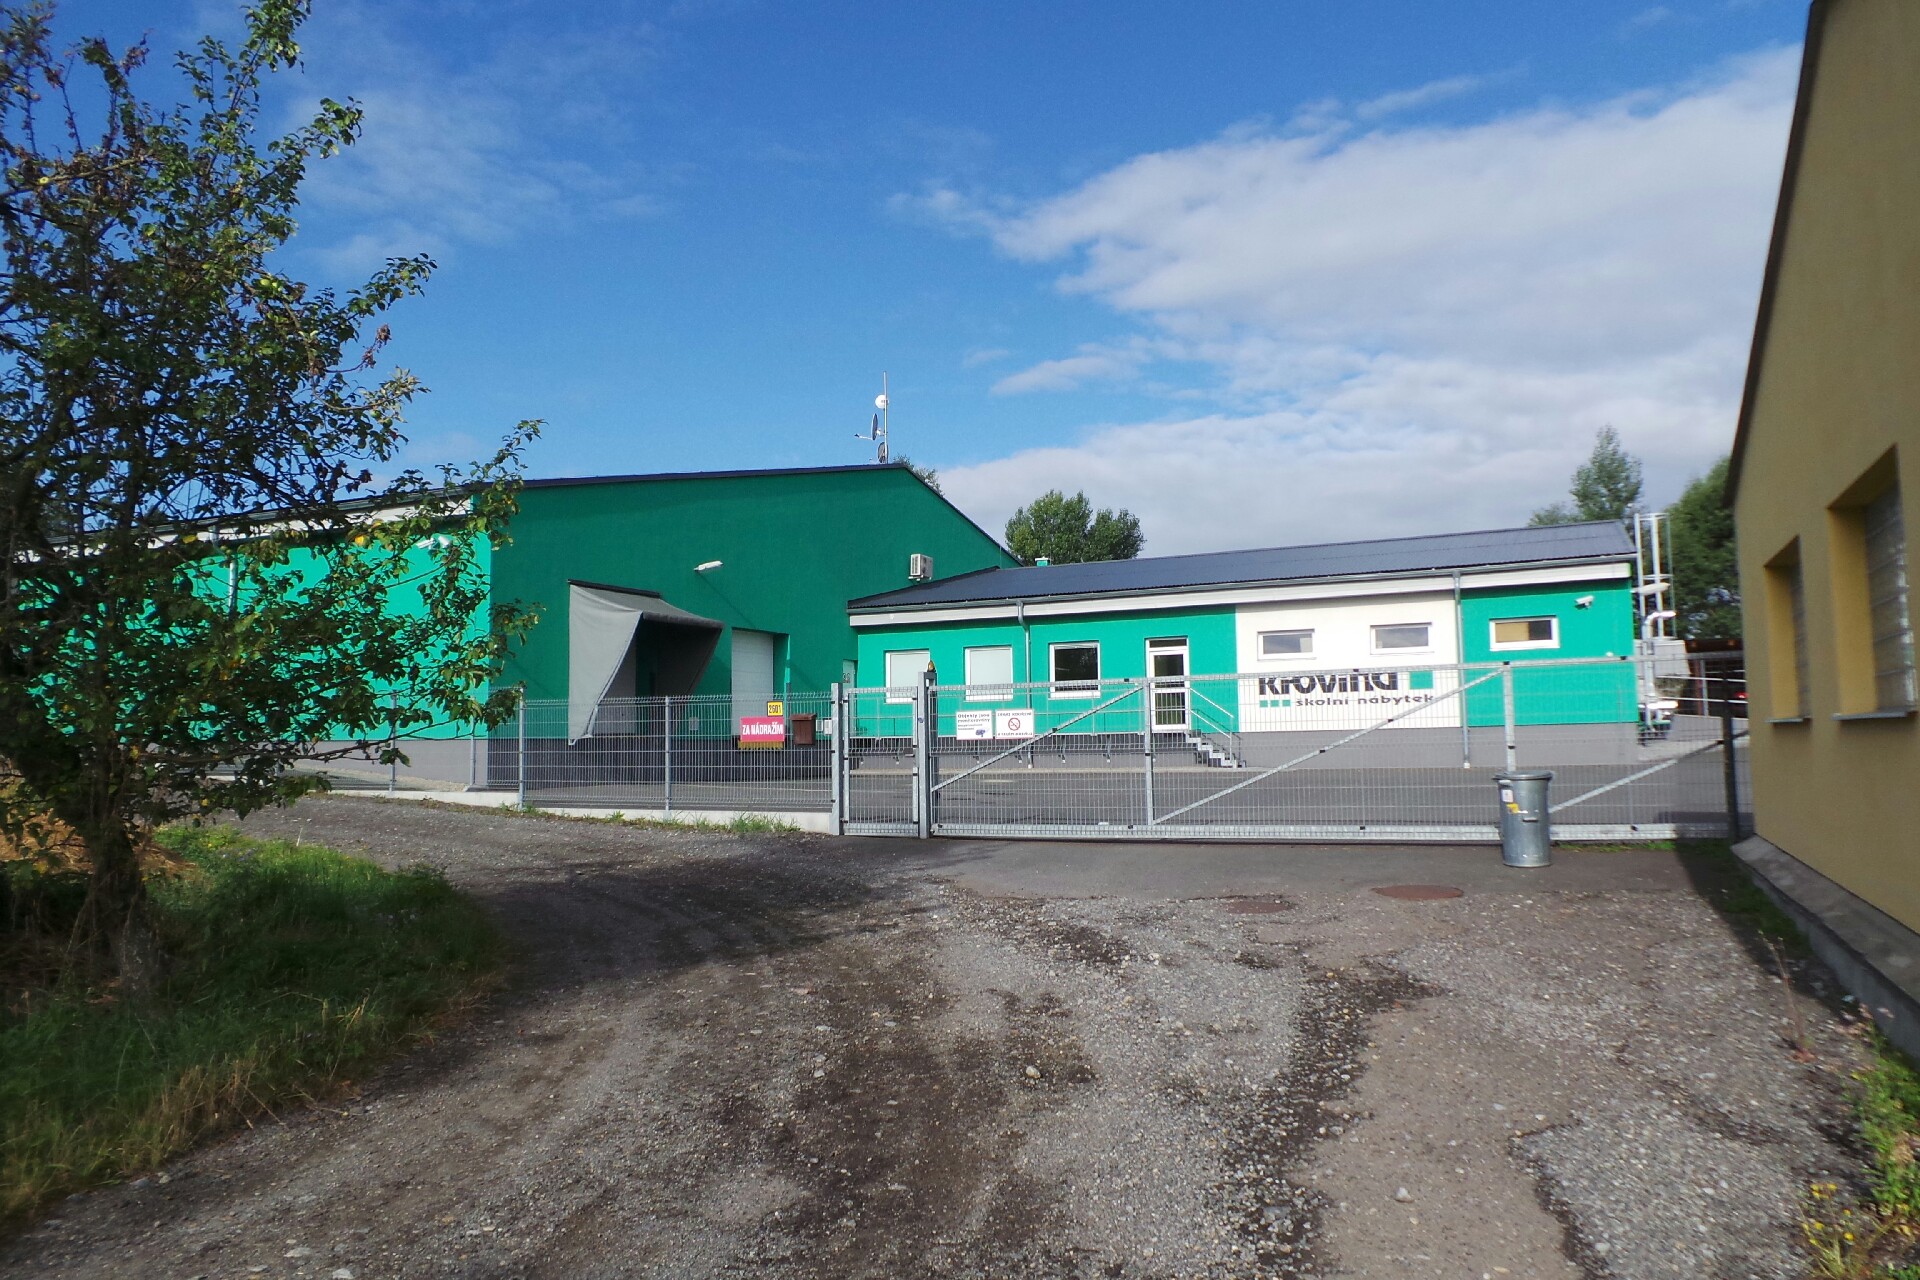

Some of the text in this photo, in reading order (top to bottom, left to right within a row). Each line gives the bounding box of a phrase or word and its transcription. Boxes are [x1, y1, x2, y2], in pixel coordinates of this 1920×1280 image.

[1296, 694, 1434, 707] školní nábytek
[742, 721, 784, 735] ZA NÁDRAŽÍM
